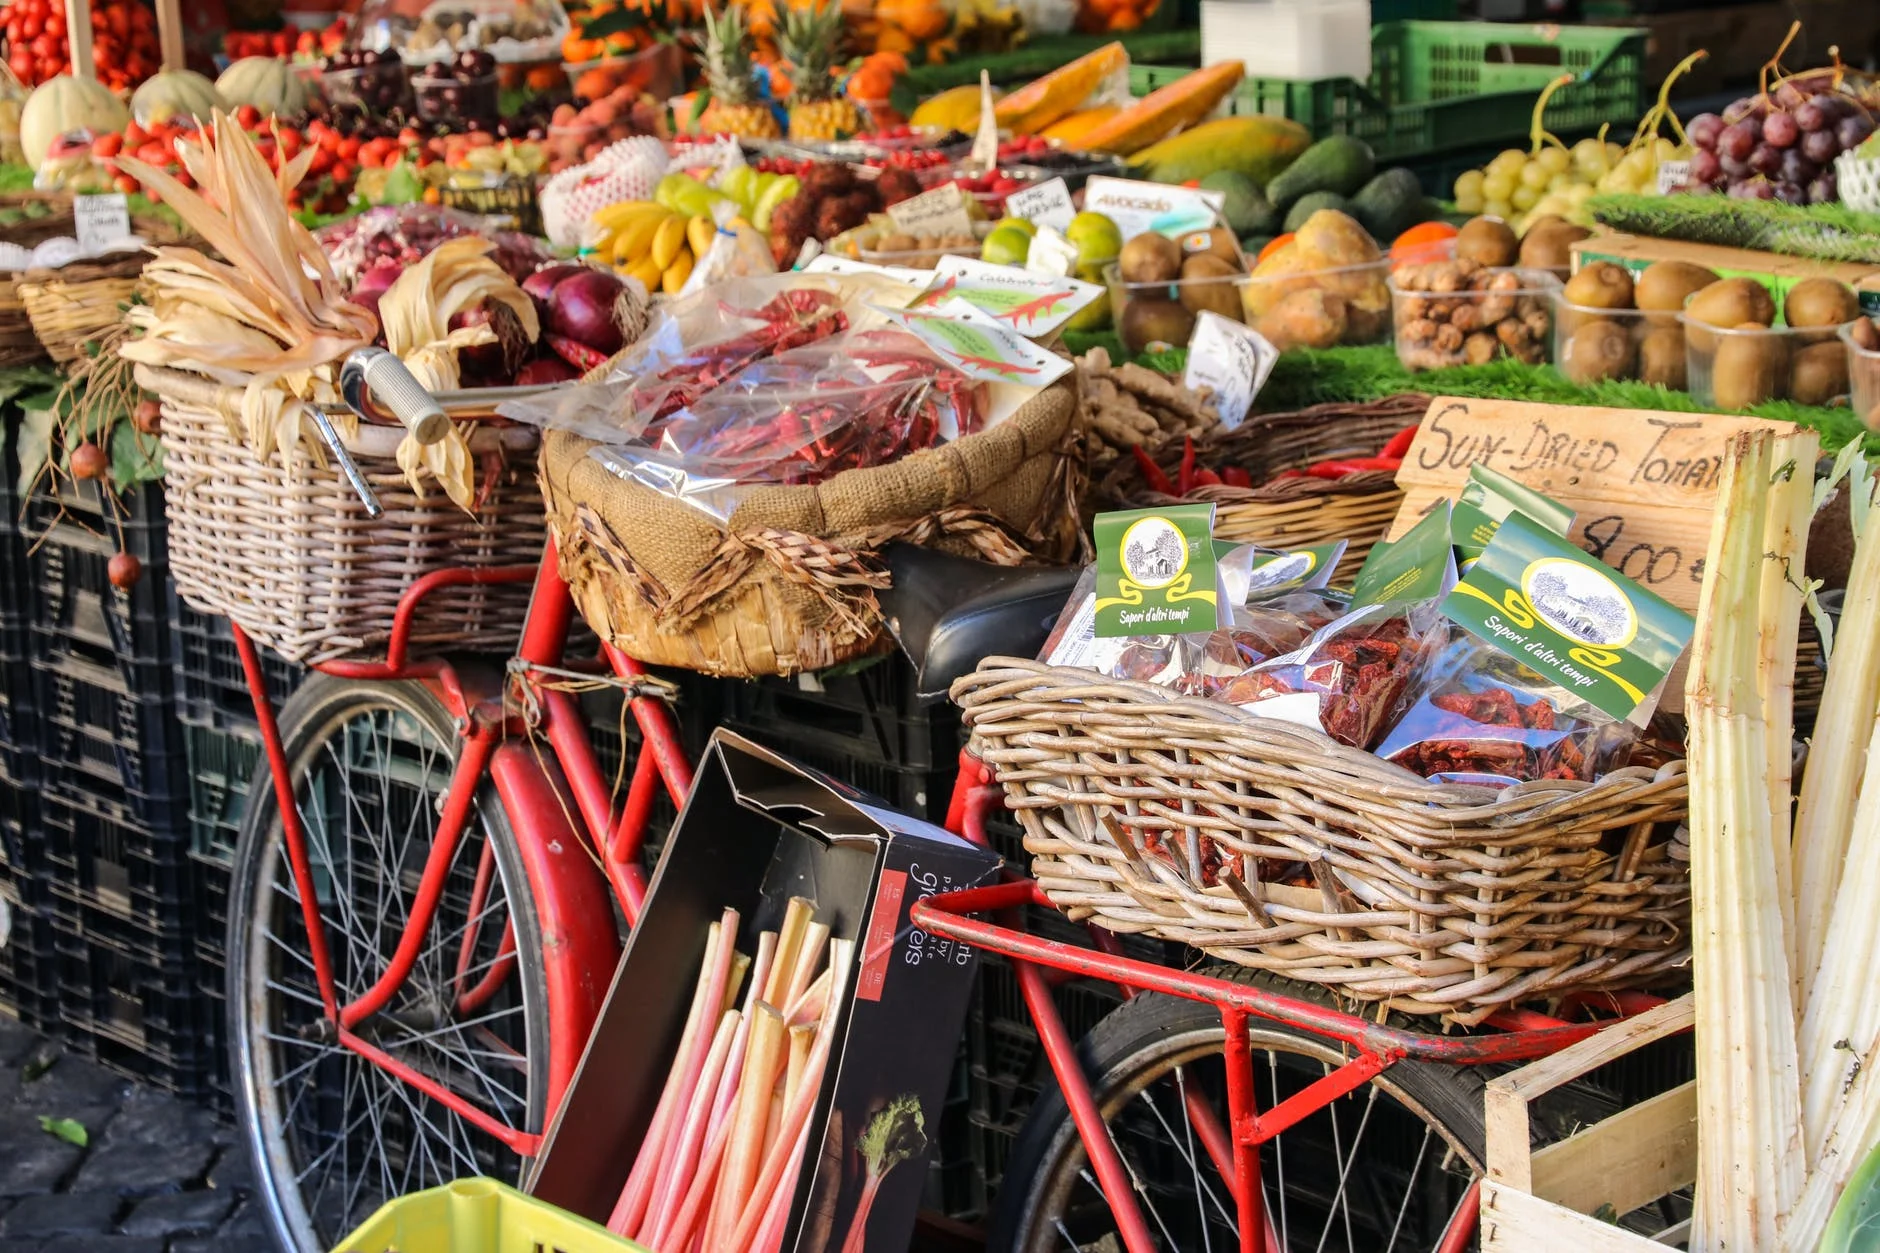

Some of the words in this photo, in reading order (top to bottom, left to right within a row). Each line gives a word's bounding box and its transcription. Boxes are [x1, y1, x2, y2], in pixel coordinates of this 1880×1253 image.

[1629, 418, 1722, 488] TOMAT
[1119, 609, 1145, 628] Sapori
[1145, 606, 1169, 622] d'altri
[1168, 606, 1191, 625] tempi
[1484, 615, 1528, 645] Sapori
[1523, 642, 1563, 667] d'altri
[1559, 661, 1599, 687] tempi
